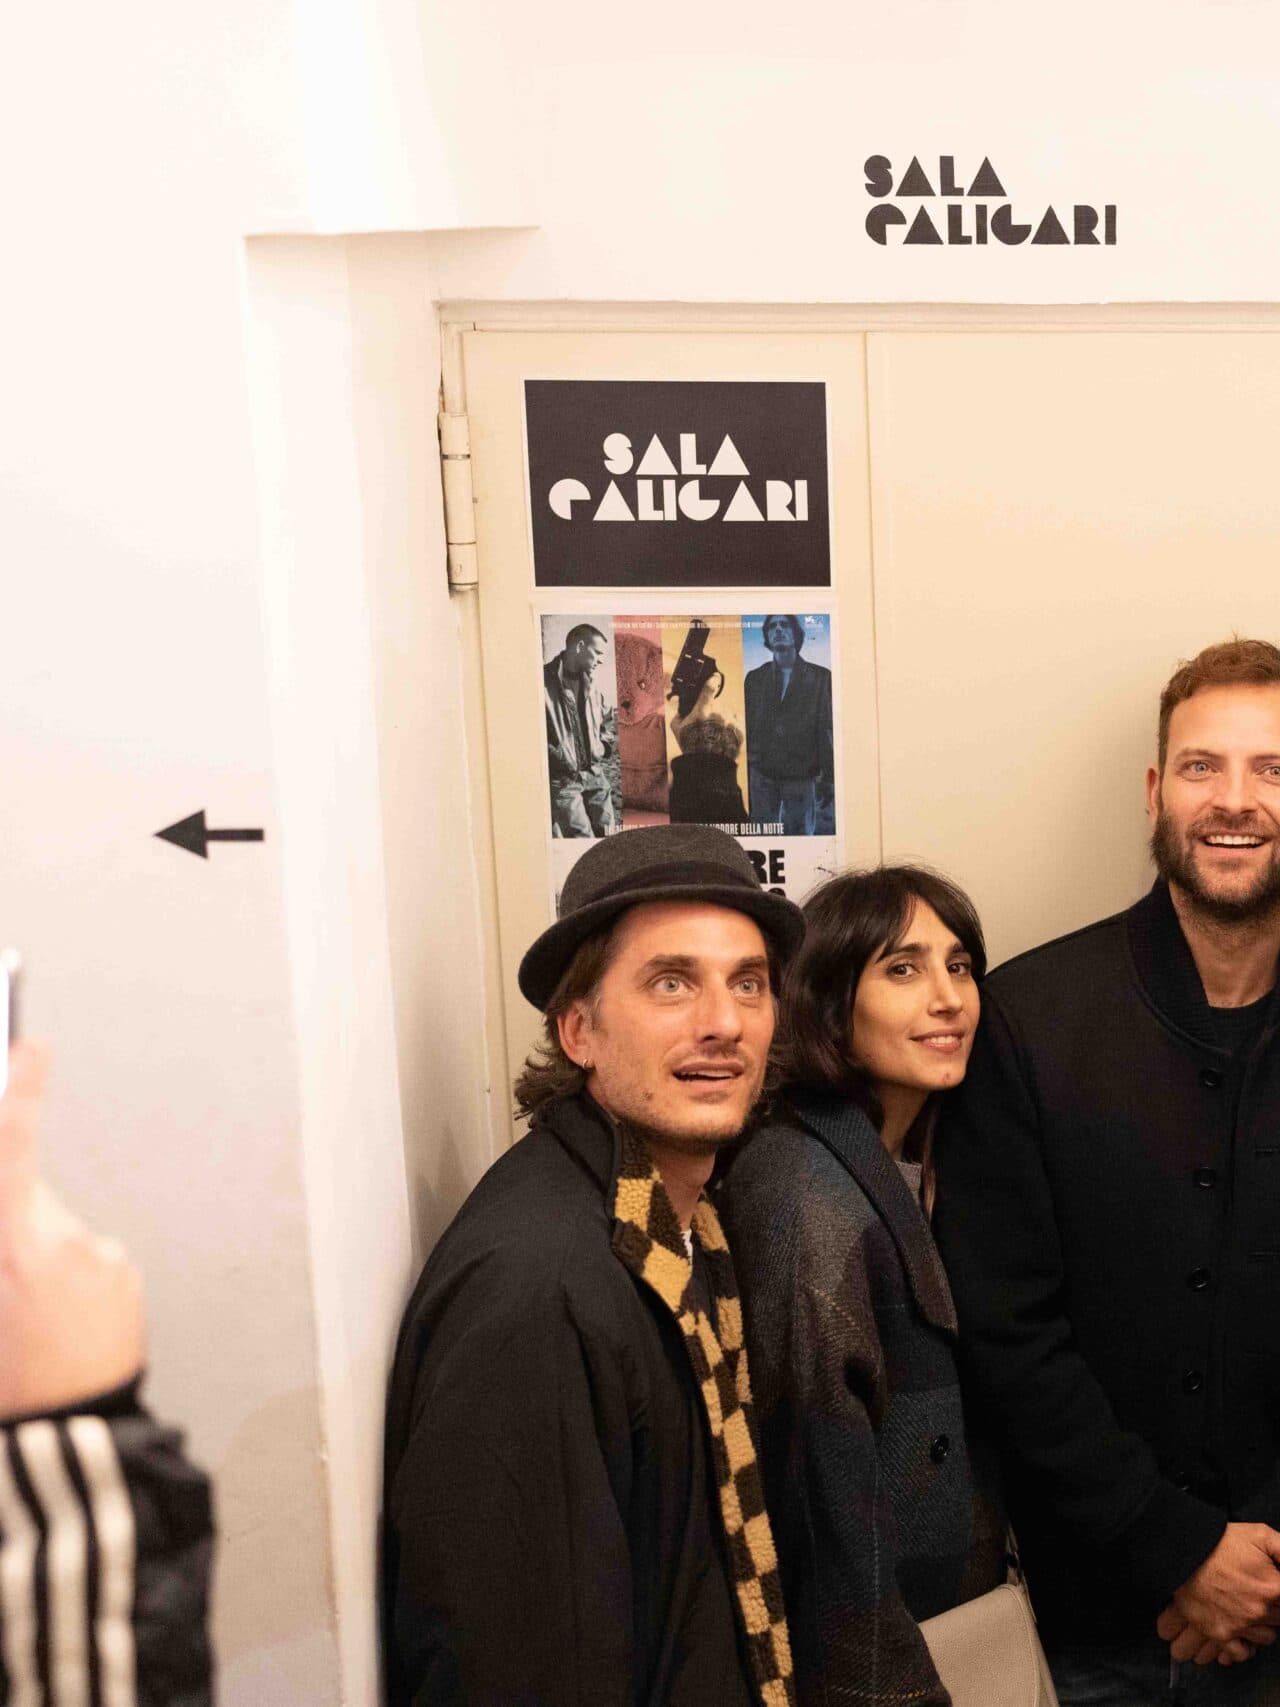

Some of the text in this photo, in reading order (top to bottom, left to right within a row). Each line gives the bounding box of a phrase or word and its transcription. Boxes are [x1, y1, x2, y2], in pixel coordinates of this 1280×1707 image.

[864, 154, 1007, 198] SALA
[865, 203, 1117, 246] CALIGARI
[603, 432, 750, 476] SALA
[548, 478, 809, 522] CALIGARI
[740, 822, 761, 835] DELLA
[763, 822, 784, 835] NOTTE
